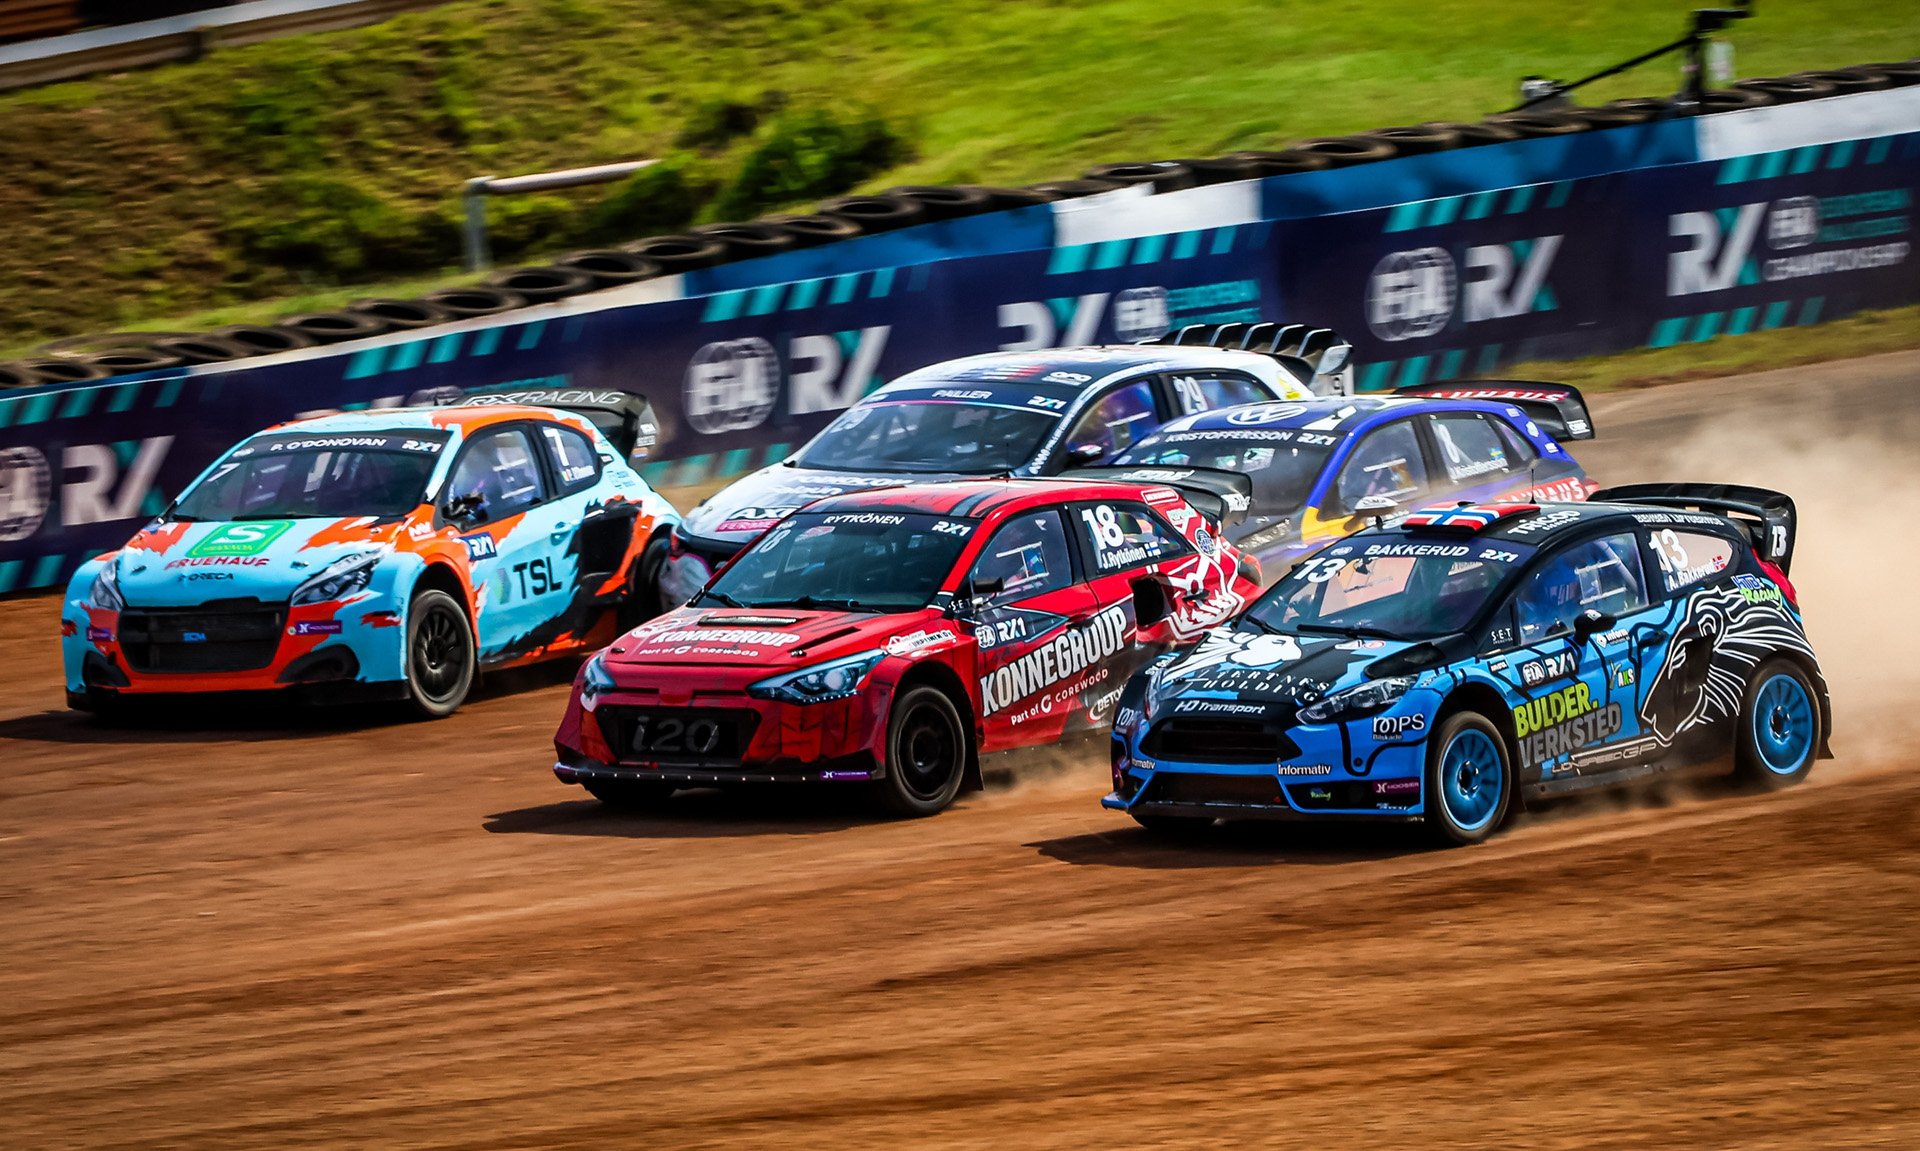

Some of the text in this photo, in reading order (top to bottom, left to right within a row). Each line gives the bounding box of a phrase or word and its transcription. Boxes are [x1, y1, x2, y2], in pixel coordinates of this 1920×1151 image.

[932, 389, 993, 400] PAILLER
[286, 437, 387, 450] O'DONOVAN
[402, 440, 442, 452] RX1
[543, 428, 570, 467] 7
[1164, 431, 1337, 446] KRISTOFFERSSON RX1
[823, 513, 971, 537] RYTKÖNEN RX1
[1081, 505, 1125, 550] 18
[1363, 544, 1470, 557] BAKKERUD
[1479, 549, 1519, 563] RX1
[1649, 528, 1689, 573] 13
[1770, 525, 1787, 557] 13
[163, 556, 271, 570] FRUEHAUF
[1293, 557, 1347, 583] 13
[513, 556, 563, 600] TSL
[1740, 584, 1783, 610] Racing
[649, 629, 801, 647] KONNEGROUP
[996, 616, 1027, 643] RX1
[692, 647, 759, 657] COREWOOD
[979, 605, 1128, 718] KONNEGROUP
[1547, 652, 1576, 678] RX1
[1202, 678, 1319, 702] HOLDING
[1618, 668, 1635, 688] AKS
[1010, 709, 1030, 726] Part
[1030, 704, 1040, 717] of
[1055, 668, 1109, 703] COREWOOD
[1174, 700, 1266, 715] HD Transport
[1513, 682, 1599, 738] BULDER.
[631, 715, 720, 753] i20
[1518, 703, 1622, 769] VERKSTED
